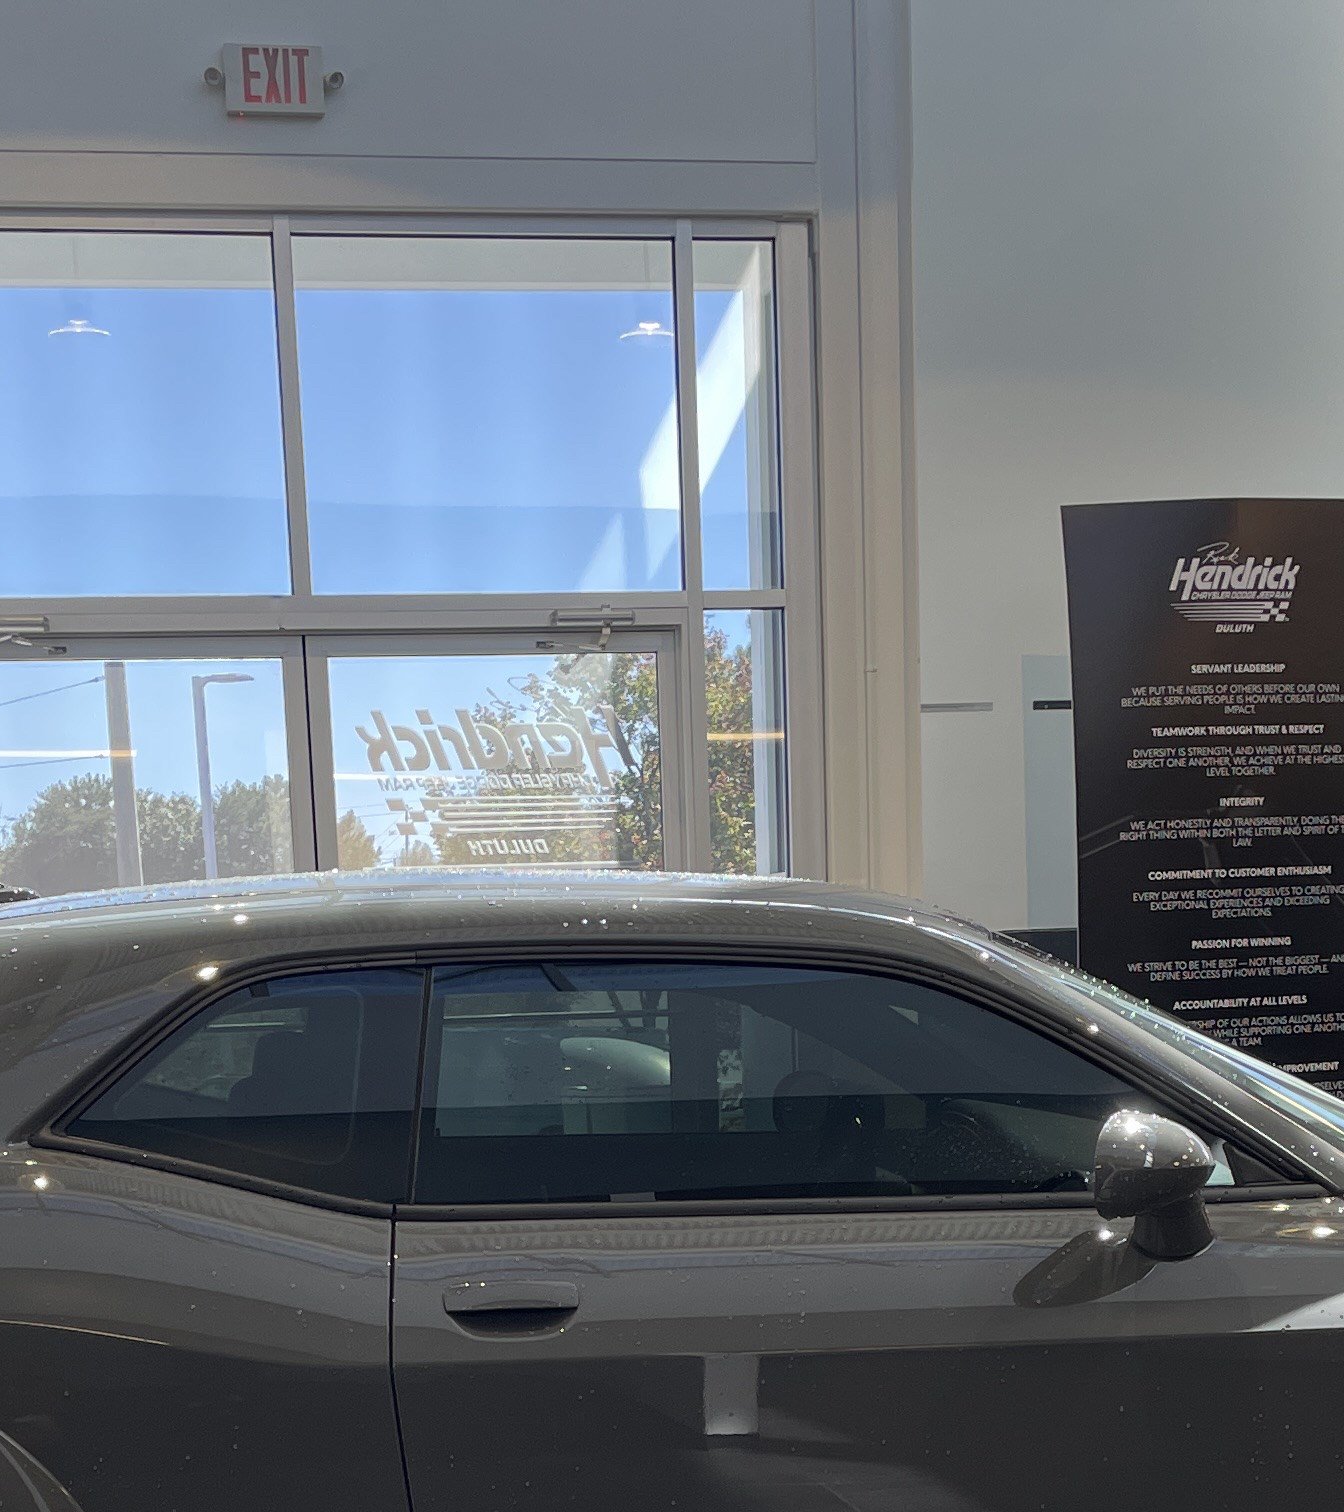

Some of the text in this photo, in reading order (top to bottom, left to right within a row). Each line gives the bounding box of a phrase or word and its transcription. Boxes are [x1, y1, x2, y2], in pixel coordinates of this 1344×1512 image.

[241, 47, 309, 104] EXIT
[1169, 557, 1301, 600] Hendrick
[1215, 624, 1253, 632] DULUTH
[1191, 664, 1285, 673] SERVANT LEADERSHIP
[1151, 725, 1323, 736] TEAMWORK THROUGH TRUST & RESPECT
[1219, 797, 1263, 806] INTEGRITY
[1148, 866, 1331, 879] COMMITMENT TO CUSTOMER ENTHUSIASM
[1191, 937, 1291, 949] PASSION FOR WINNING
[1173, 995, 1306, 1010] ACCOUNTABILITY AT ALL LEVELS
